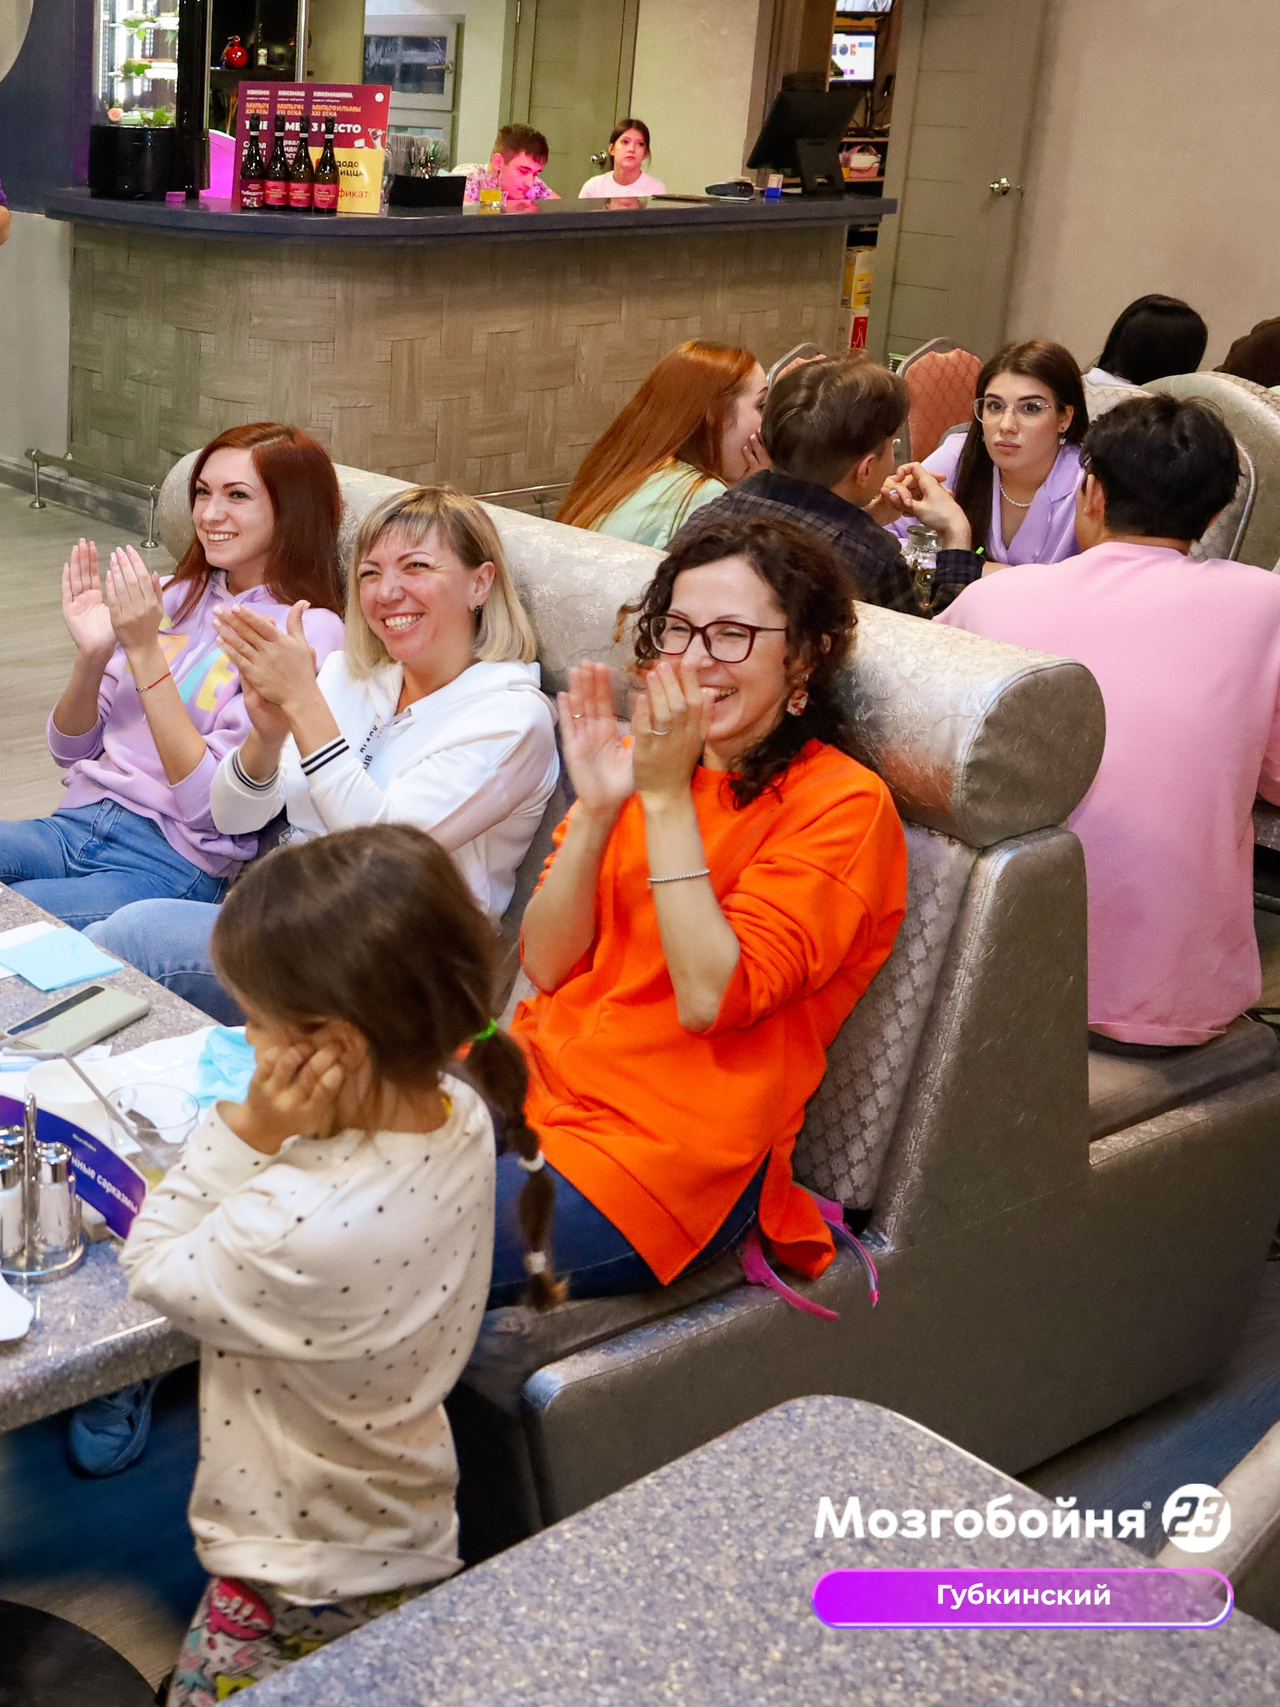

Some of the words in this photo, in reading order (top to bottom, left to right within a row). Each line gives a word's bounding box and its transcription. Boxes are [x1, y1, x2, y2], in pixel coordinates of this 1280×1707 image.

[311, 122, 319, 132] 3
[338, 187, 369, 199] фикат
[71, 1155, 96, 1180] нные
